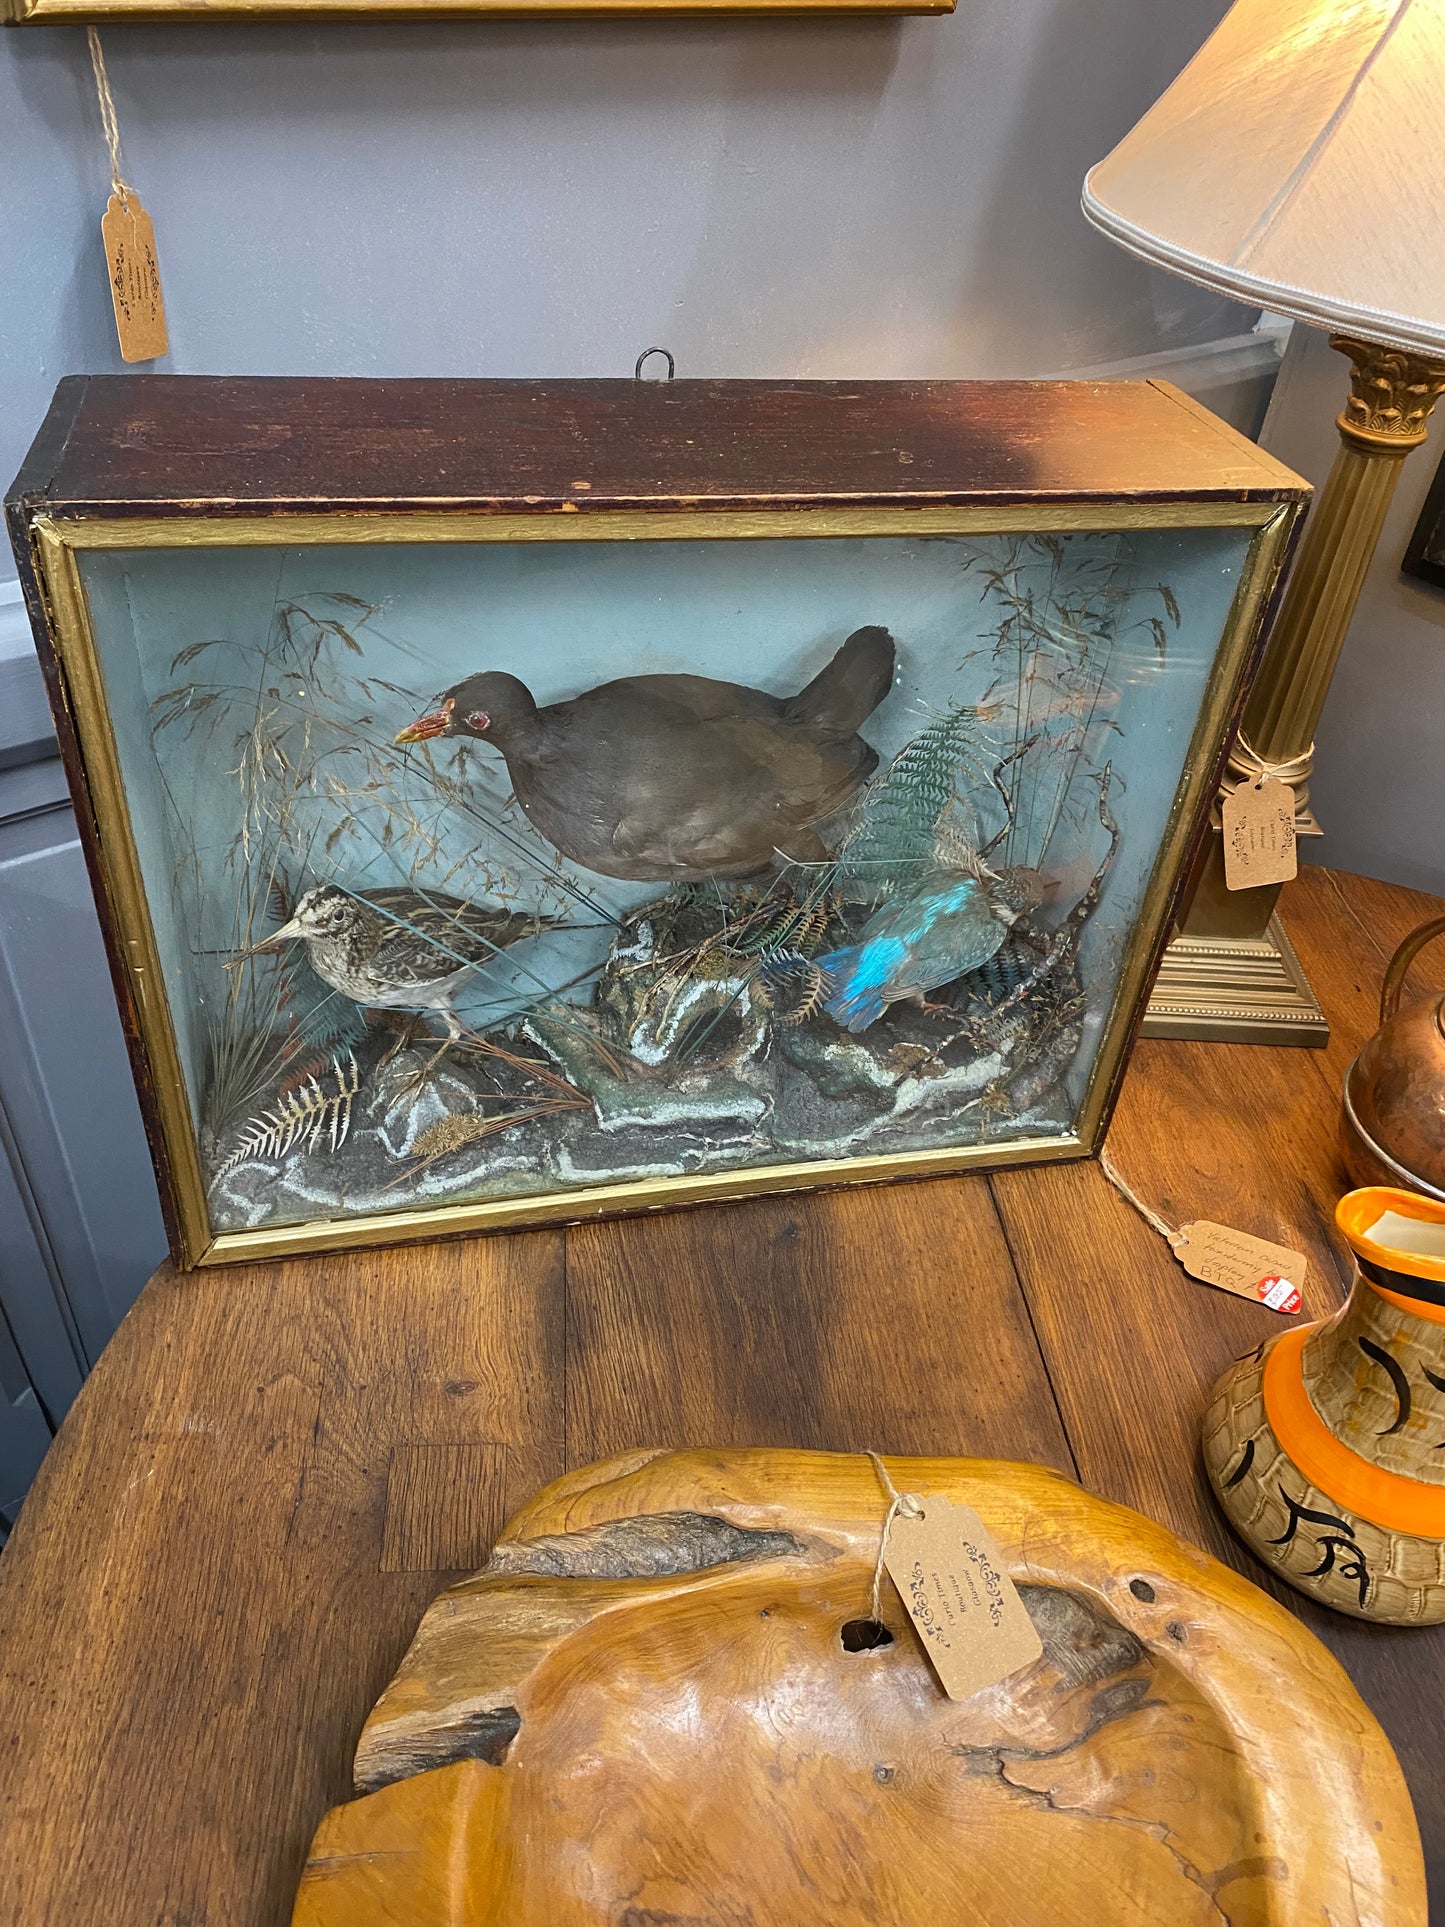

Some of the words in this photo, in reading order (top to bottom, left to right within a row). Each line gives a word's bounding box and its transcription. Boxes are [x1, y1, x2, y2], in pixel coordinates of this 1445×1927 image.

[1260, 1279, 1276, 1294] Sale
[1282, 1294, 1300, 1310] Price
[931, 1572, 946, 1598] Times
[962, 1569, 981, 1606] Glasgow
